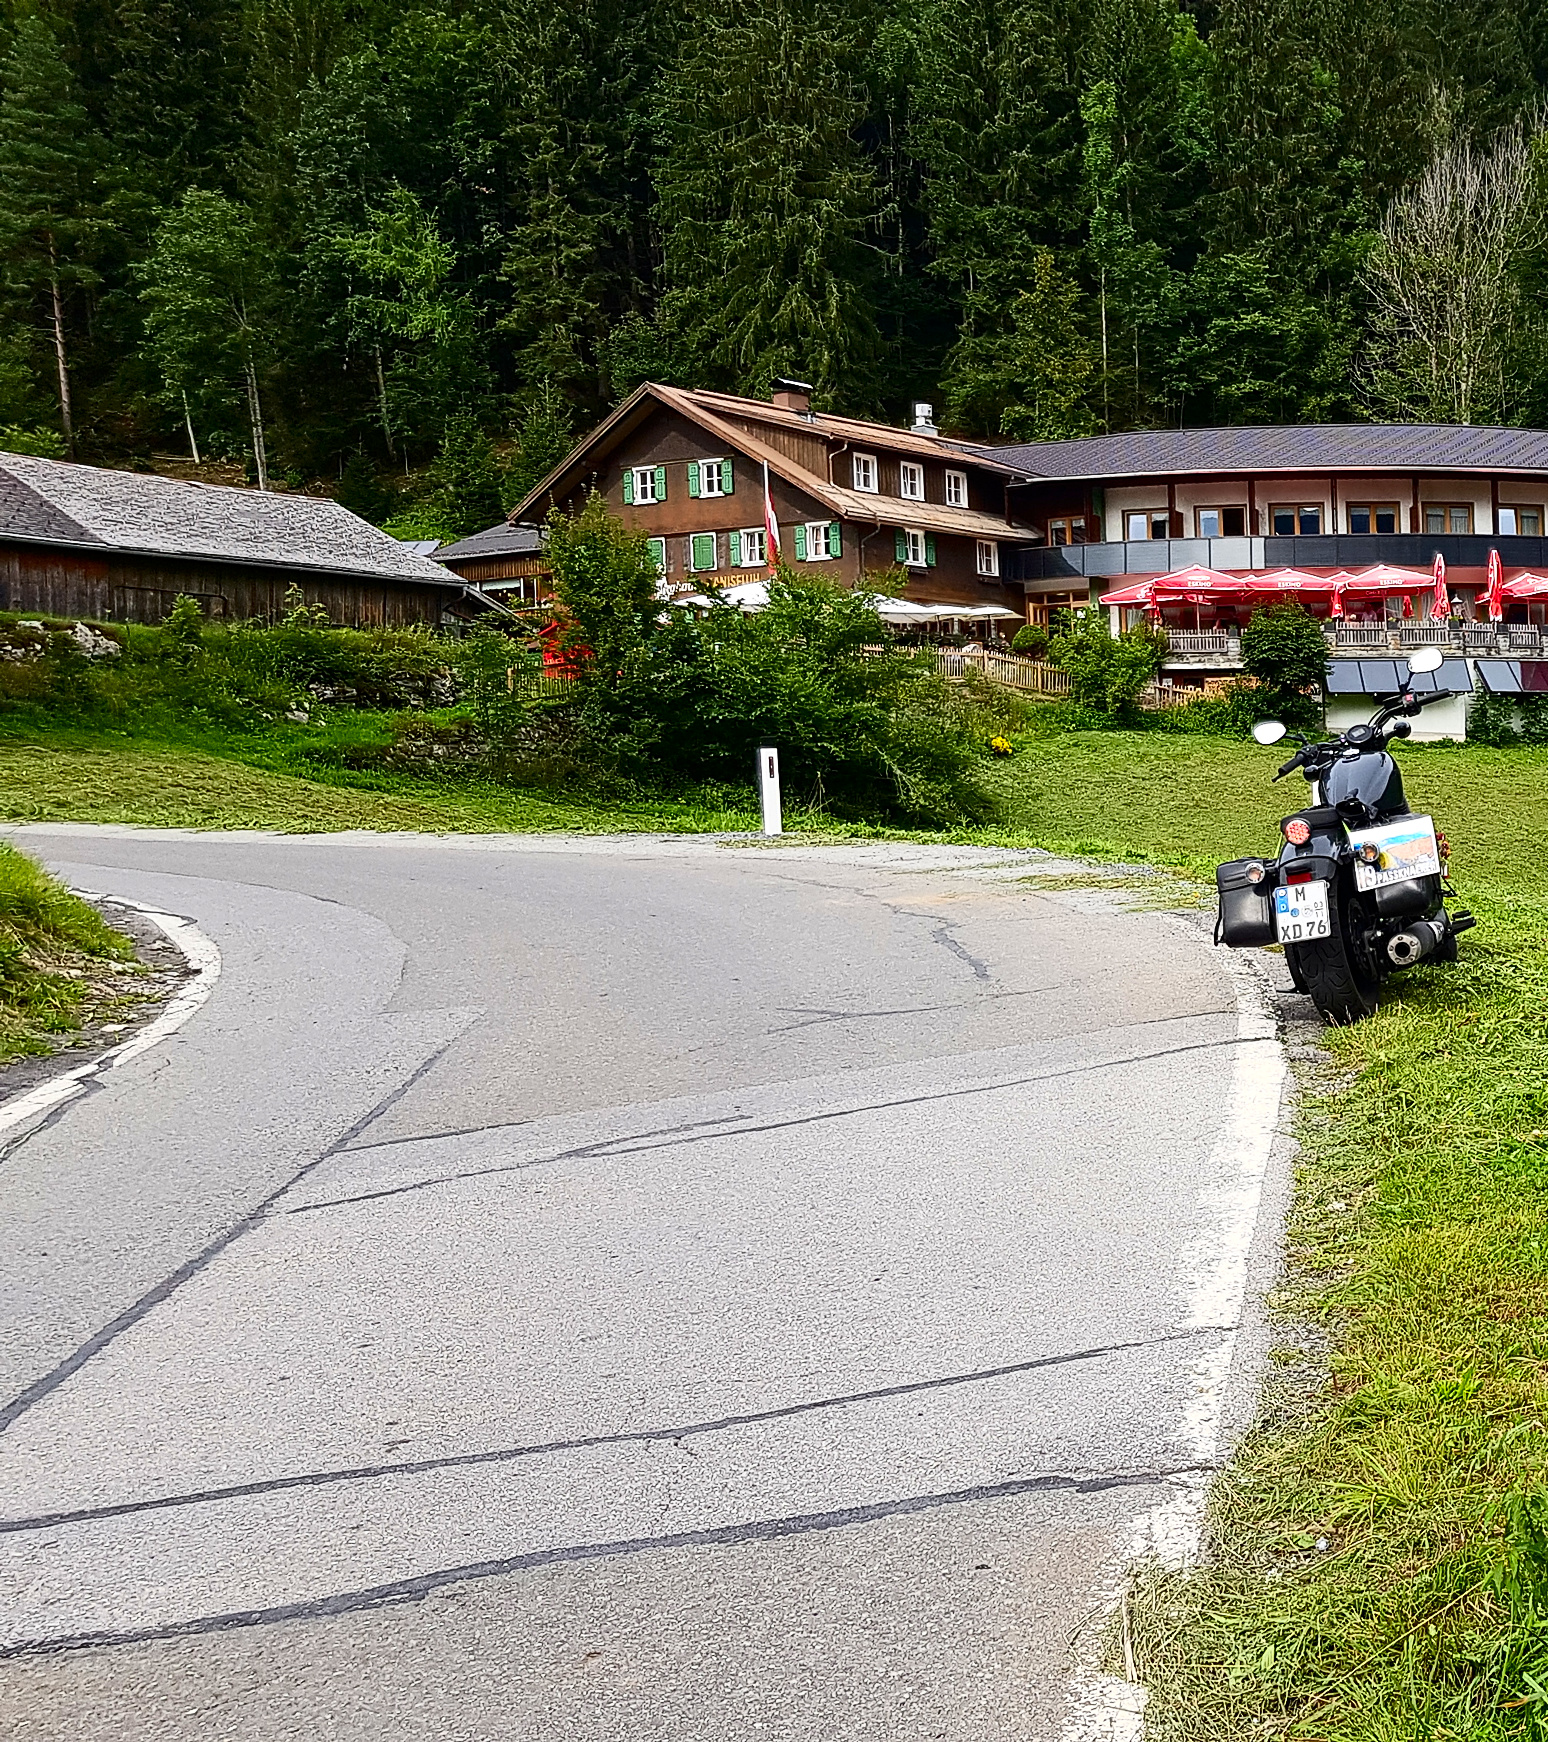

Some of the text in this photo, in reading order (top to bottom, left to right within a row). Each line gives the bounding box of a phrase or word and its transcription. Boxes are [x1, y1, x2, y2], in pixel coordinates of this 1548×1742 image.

[1295, 886, 1306, 902] M
[1281, 919, 1327, 941] XD 76
